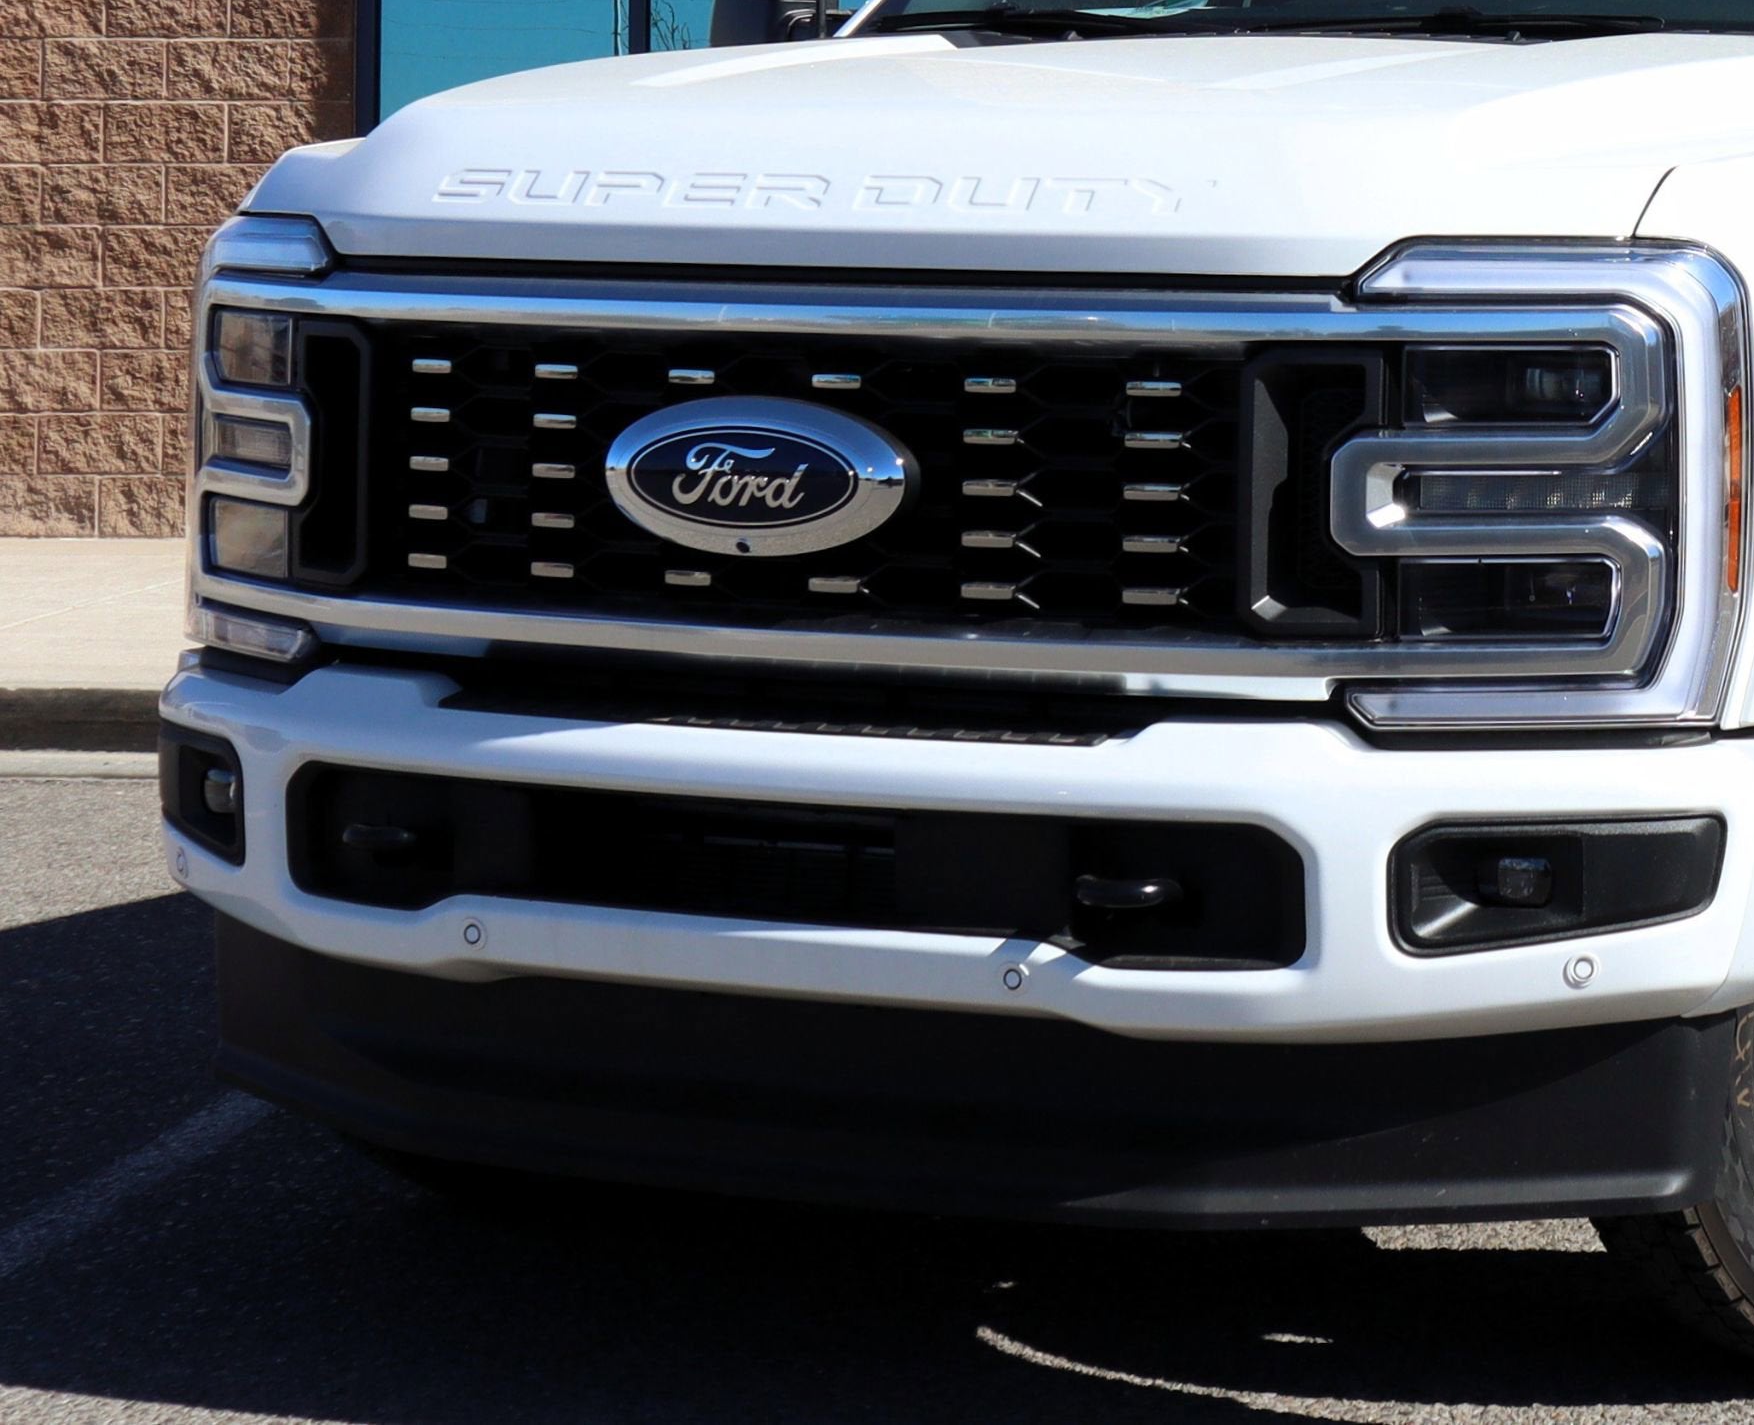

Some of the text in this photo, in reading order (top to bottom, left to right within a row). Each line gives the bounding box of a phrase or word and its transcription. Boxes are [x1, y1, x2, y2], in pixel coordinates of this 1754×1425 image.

[432, 168, 1218, 216] SUPER DUTY
[672, 442, 809, 509] Ford
